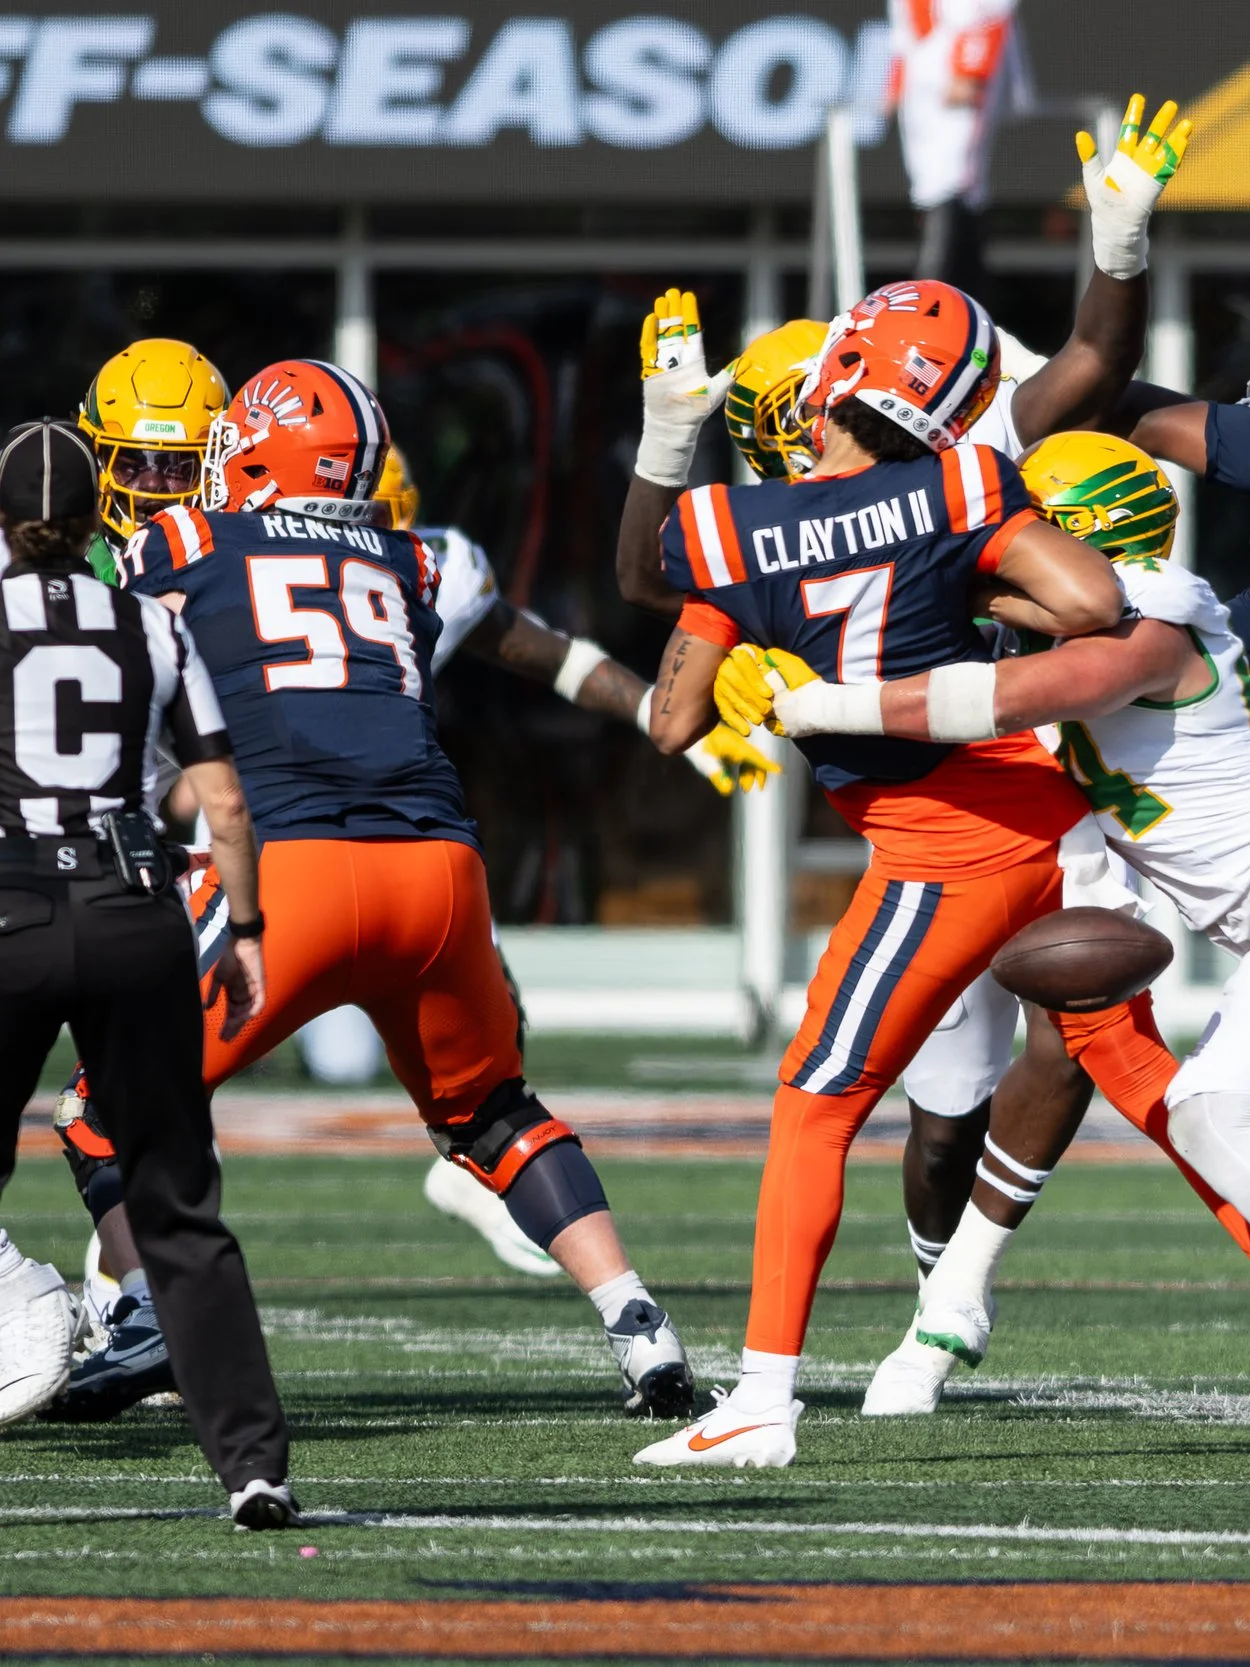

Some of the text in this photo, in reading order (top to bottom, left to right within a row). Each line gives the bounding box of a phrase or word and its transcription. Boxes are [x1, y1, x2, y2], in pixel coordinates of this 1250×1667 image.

[0, 13, 899, 148] F-SEASO
[144, 422, 176, 433] OREGON
[243, 379, 307, 426] ILLINI
[752, 489, 935, 574] CLAYTON II
[245, 554, 423, 702] 59
[800, 562, 895, 684] 7
[13, 645, 123, 790] C
